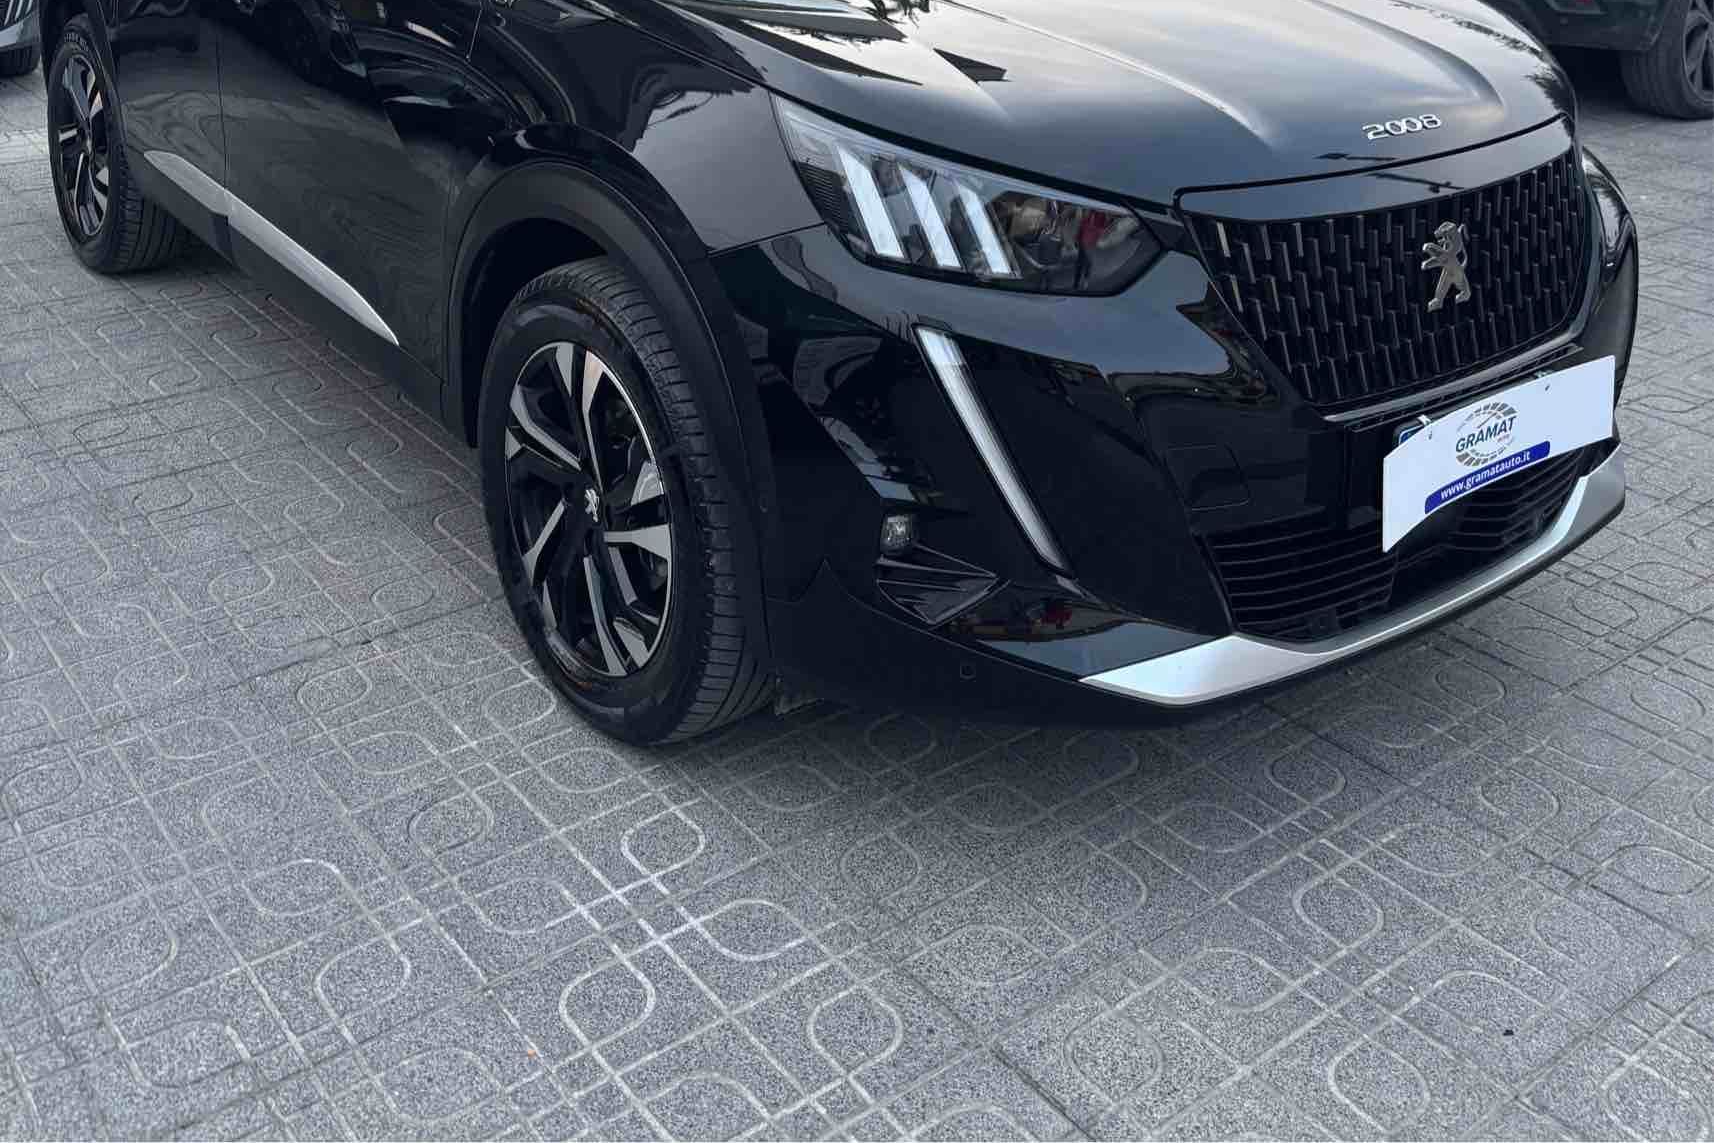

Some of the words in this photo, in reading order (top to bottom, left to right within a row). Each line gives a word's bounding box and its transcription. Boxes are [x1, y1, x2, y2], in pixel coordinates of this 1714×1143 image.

[1362, 113, 1441, 140] 2008
[1456, 416, 1517, 452] GRAMAT
[1440, 450, 1531, 500] www.gramatauto.it
